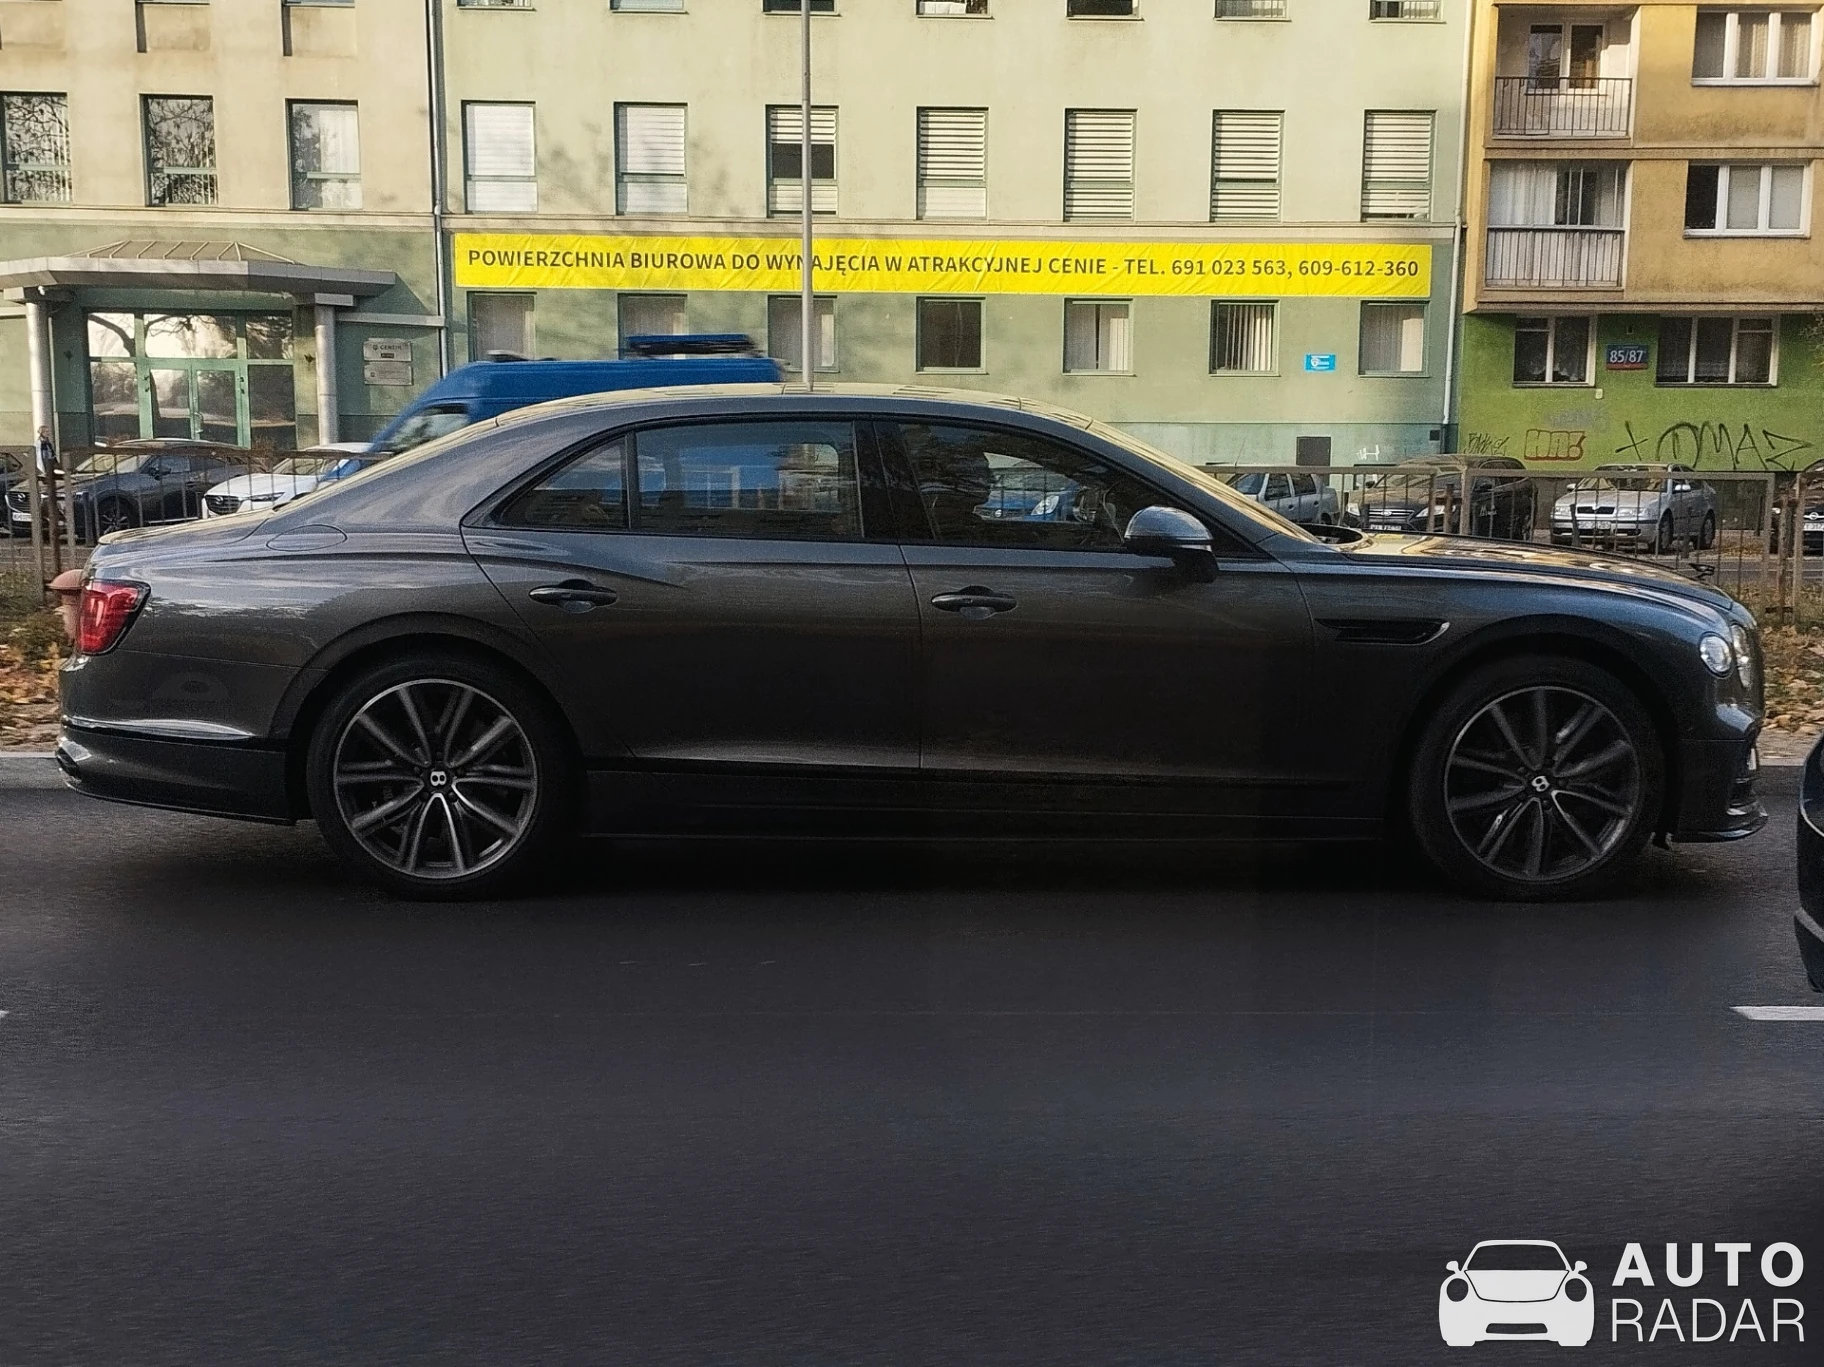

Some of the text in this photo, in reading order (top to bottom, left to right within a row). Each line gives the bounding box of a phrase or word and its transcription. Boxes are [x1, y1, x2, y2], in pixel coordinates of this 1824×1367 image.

[468, 249, 624, 268] POWIERZCHNIA
[630, 252, 726, 270] BIUROWA
[732, 254, 760, 270] DO
[885, 256, 902, 272] W
[907, 256, 1042, 273] ATRAKCYJNEJ
[1048, 258, 1106, 274] CENIE
[1124, 259, 1165, 275] TEL.
[1172, 259, 1205, 275] 691
[1211, 259, 1245, 276] 023
[1252, 260, 1292, 279] 563,
[1299, 260, 1419, 277] 609-612-360
[1609, 350, 1643, 363] 85/87
